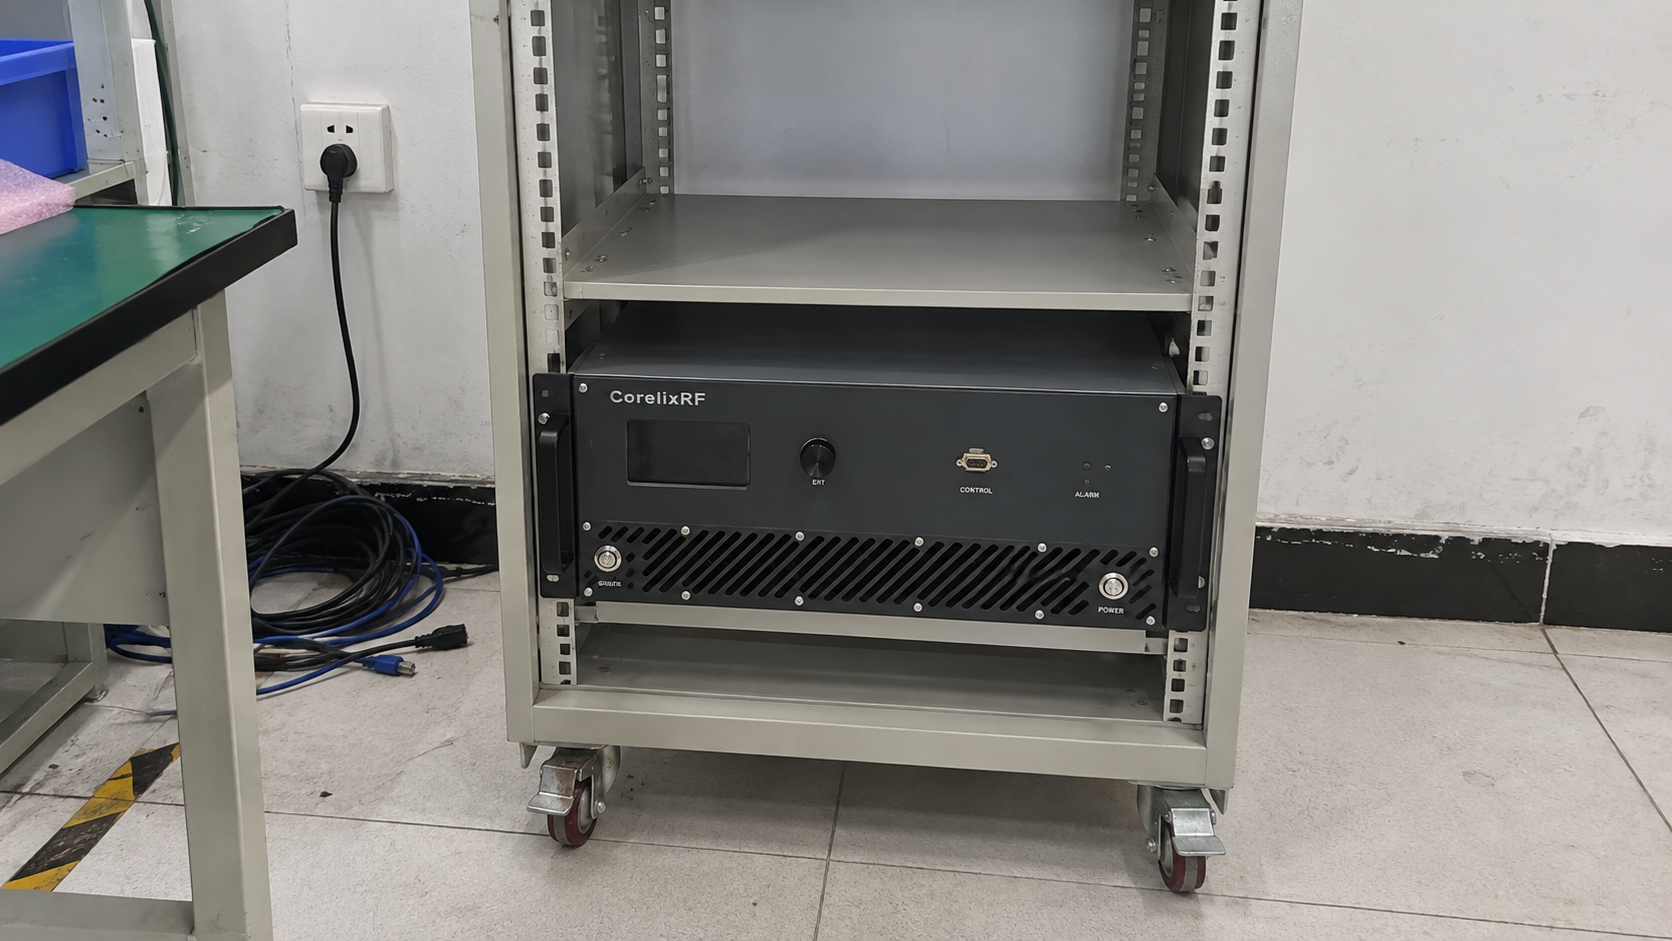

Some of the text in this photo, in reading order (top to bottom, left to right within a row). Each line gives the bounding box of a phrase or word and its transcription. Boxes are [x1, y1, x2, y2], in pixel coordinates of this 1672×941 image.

[609, 390, 706, 406] CorelixRF
[959, 486, 993, 495] CONTROL
[1097, 606, 1125, 614] POWER
